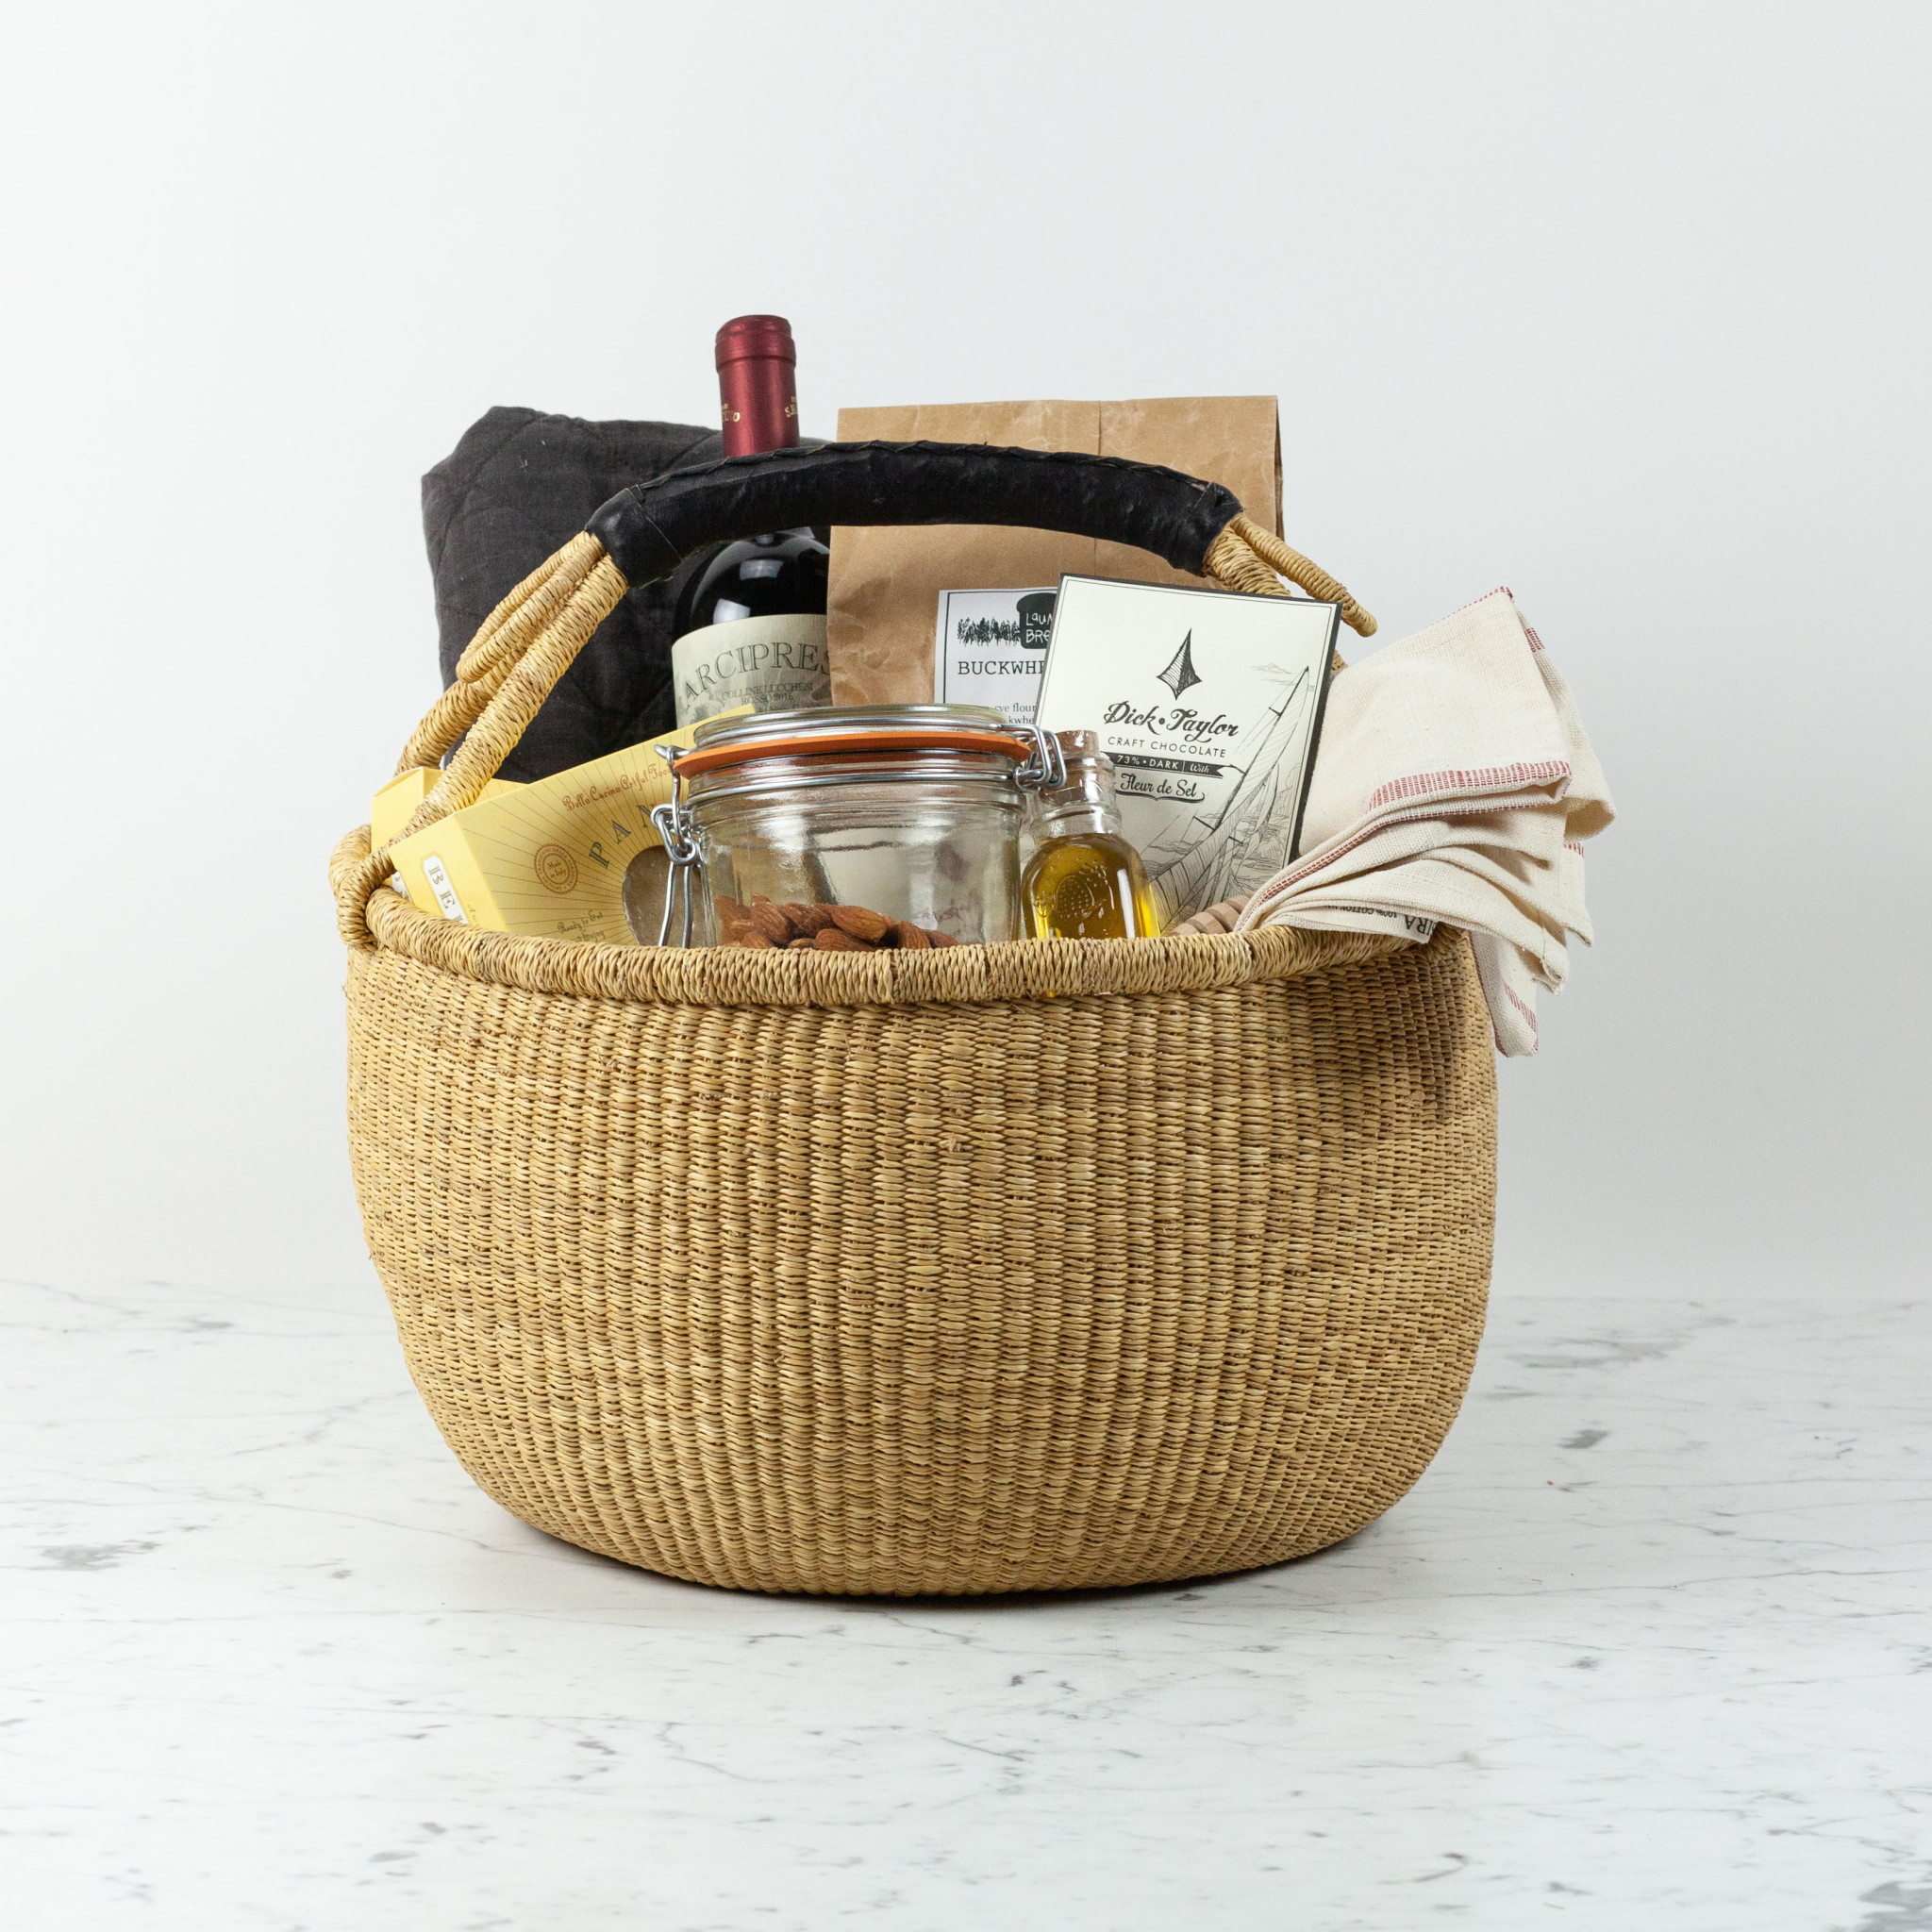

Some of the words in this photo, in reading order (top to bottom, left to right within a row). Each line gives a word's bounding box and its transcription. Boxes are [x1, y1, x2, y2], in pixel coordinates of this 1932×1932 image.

[1103, 700, 1161, 736] Dick
[1166, 708, 1240, 743] Taylor
[1108, 736, 1145, 748] CRAFT
[1150, 741, 1226, 758] CHOCOLATE
[1116, 755, 1141, 765] 73%
[1149, 758, 1179, 770] DARK
[1120, 773, 1155, 793] Fleur
[1157, 778, 1173, 794] de
[1175, 778, 1198, 798] Sel
